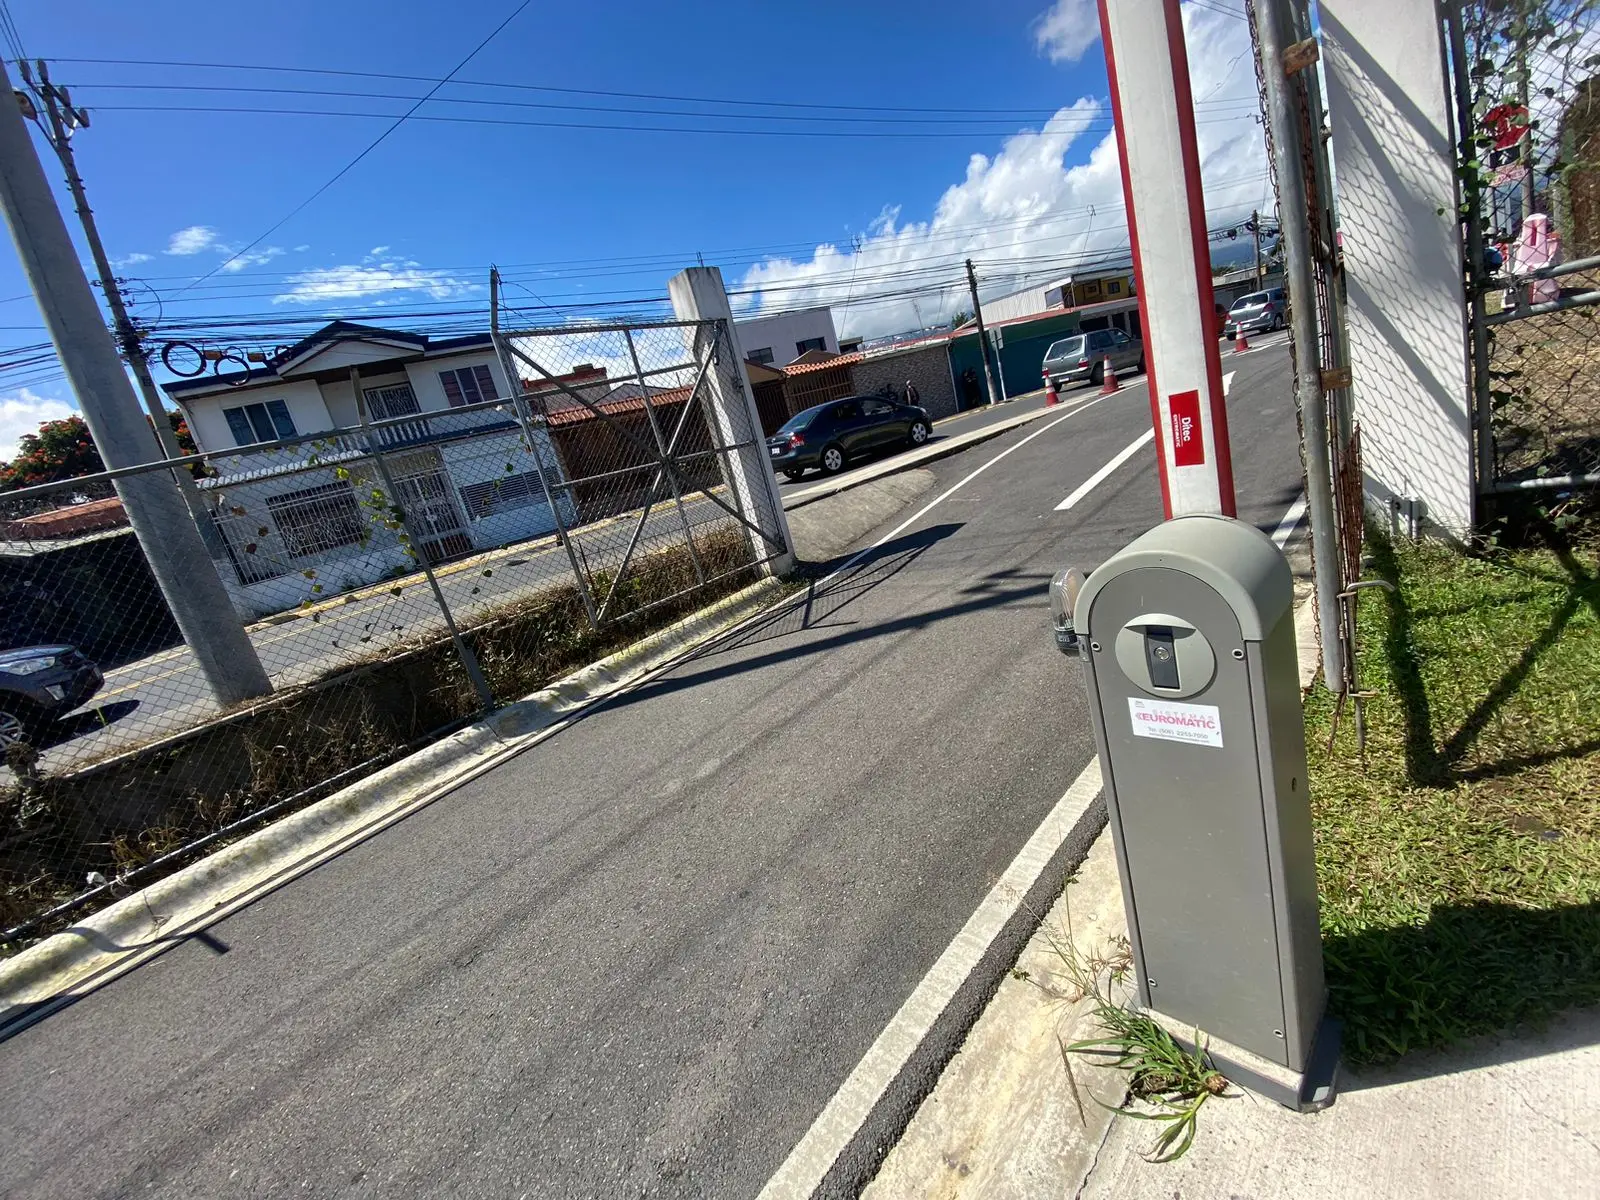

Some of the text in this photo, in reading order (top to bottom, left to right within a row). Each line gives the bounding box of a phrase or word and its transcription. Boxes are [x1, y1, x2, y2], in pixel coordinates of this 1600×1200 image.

[1181, 417, 1193, 442] Ditec
[1142, 712, 1216, 729] EUROMATIC
[1152, 708, 1214, 721] SISTEMAS
